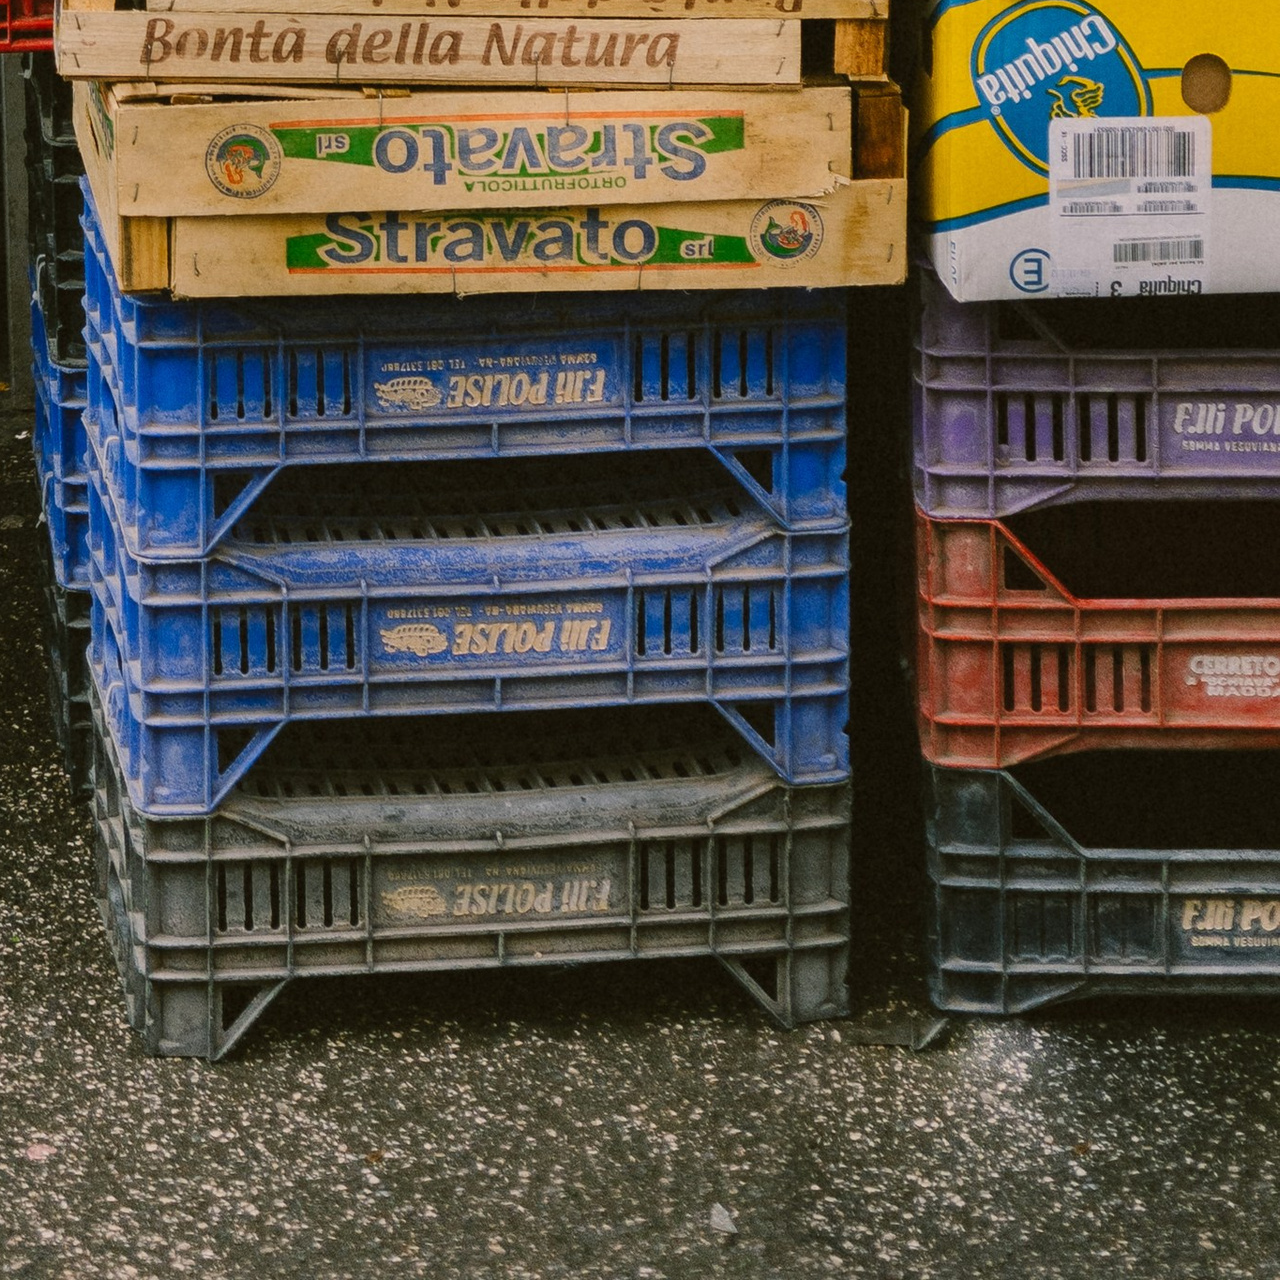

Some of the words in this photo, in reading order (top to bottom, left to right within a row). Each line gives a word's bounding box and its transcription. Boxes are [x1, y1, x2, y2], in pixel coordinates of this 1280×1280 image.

[139, 17, 309, 66] Bontà
[326, 21, 464, 66] della
[481, 22, 682, 68] Natura
[977, 15, 1117, 106] Chiquita
[317, 133, 347, 154] srl
[374, 121, 708, 185] Stravato
[463, 176, 628, 193] ORTOFRUTTICOLA
[322, 207, 659, 265] Stravato
[683, 236, 714, 260] srl
[1110, 280, 1123, 297] 3
[447, 372, 550, 409] POLISE
[1174, 402, 1226, 435] F.lli
[1182, 440, 1220, 451] SOMMA
[451, 620, 555, 656] POLISE
[1189, 655, 1280, 676] CERRETO
[453, 882, 554, 917] POLISE
[1182, 899, 1235, 931] F.lli
[1191, 936, 1231, 947] SOMMA
